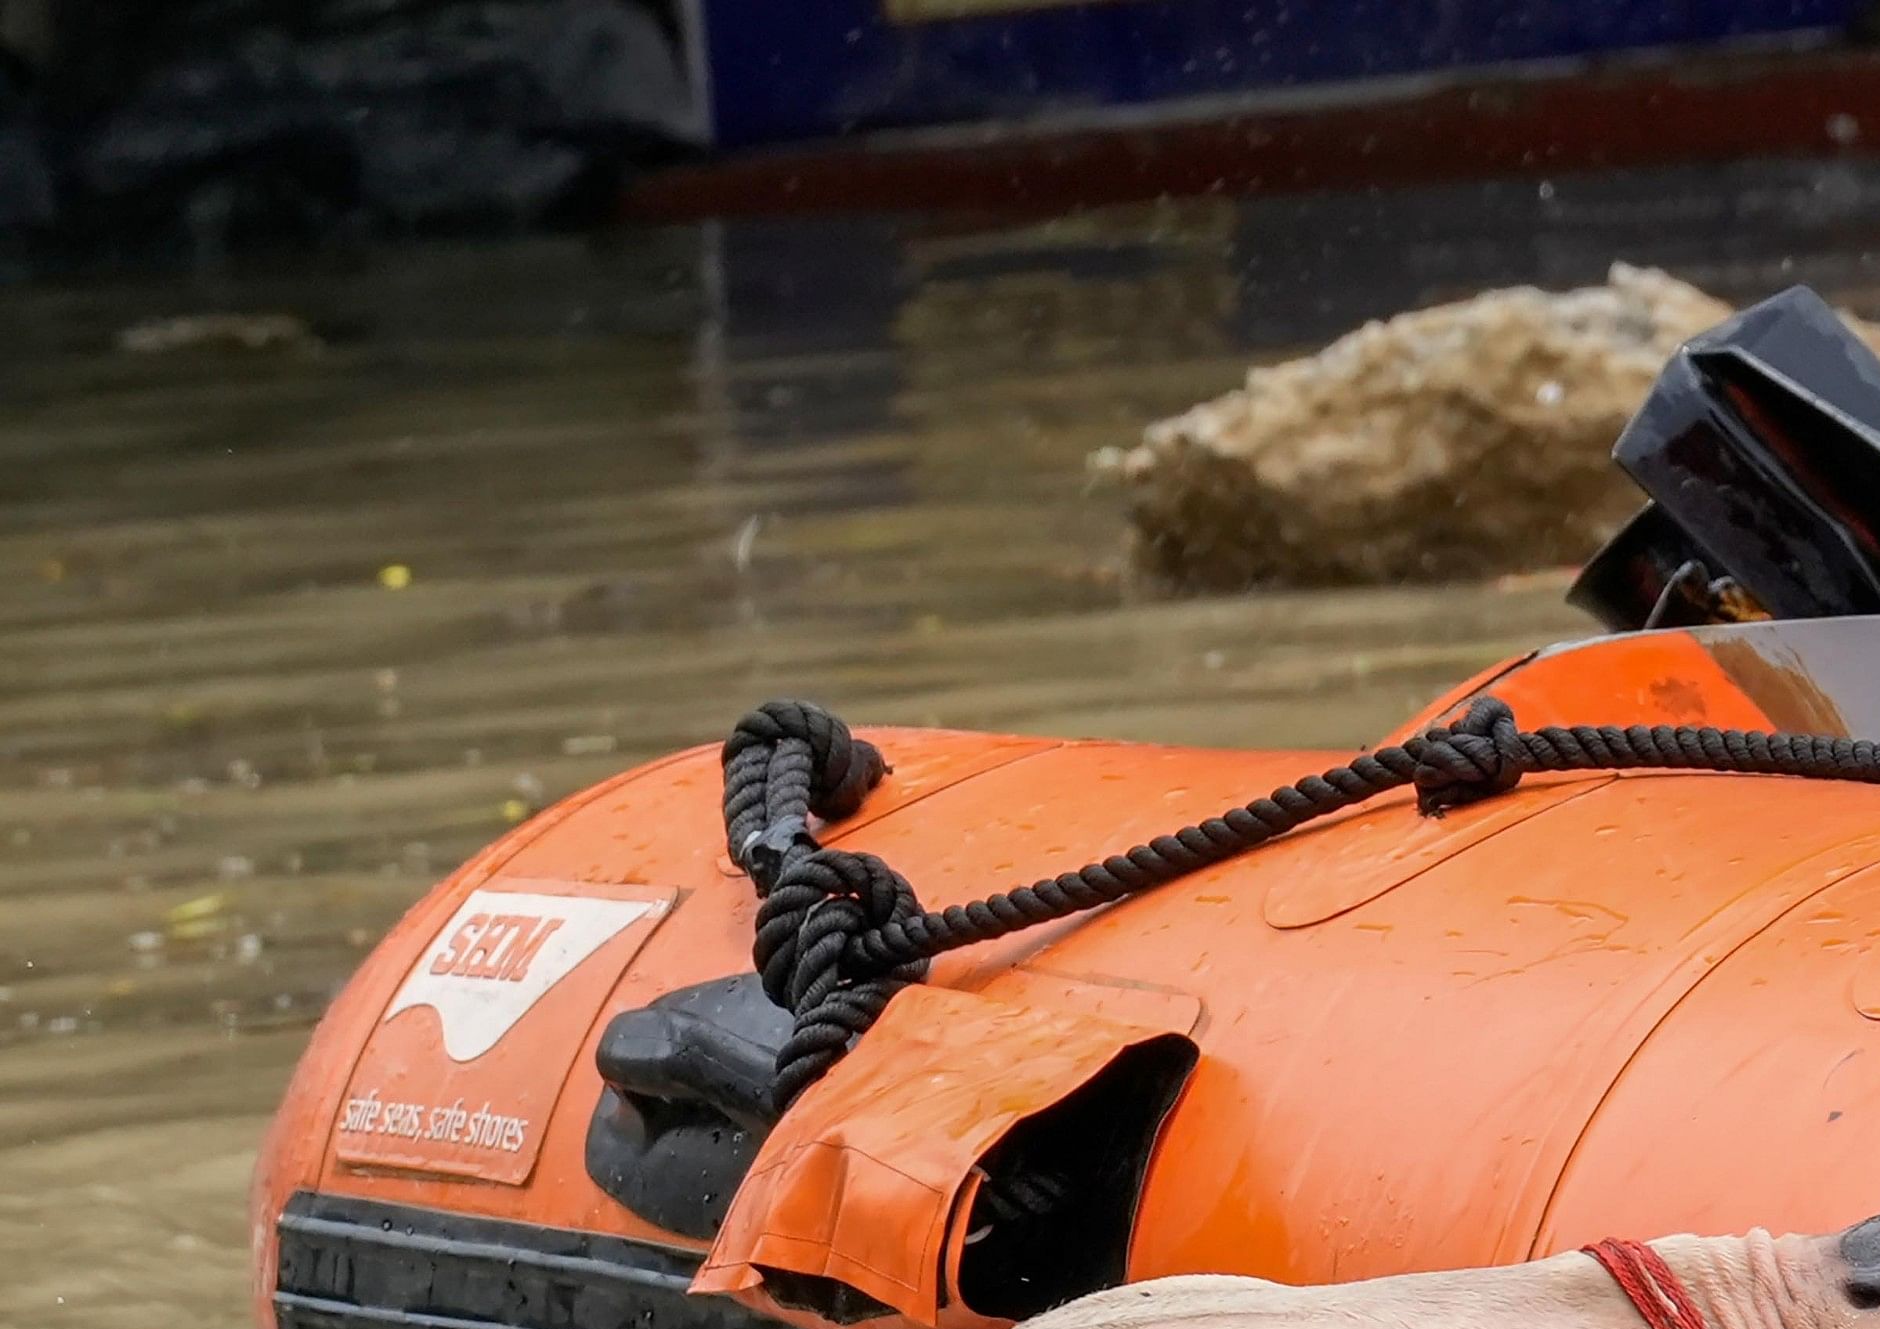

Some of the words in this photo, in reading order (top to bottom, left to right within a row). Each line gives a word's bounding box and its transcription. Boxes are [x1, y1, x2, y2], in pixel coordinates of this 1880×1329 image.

[340, 1088, 381, 1132] safe
[378, 1101, 425, 1144] seas,
[424, 1096, 467, 1143] safe
[464, 1100, 529, 1152] shores
